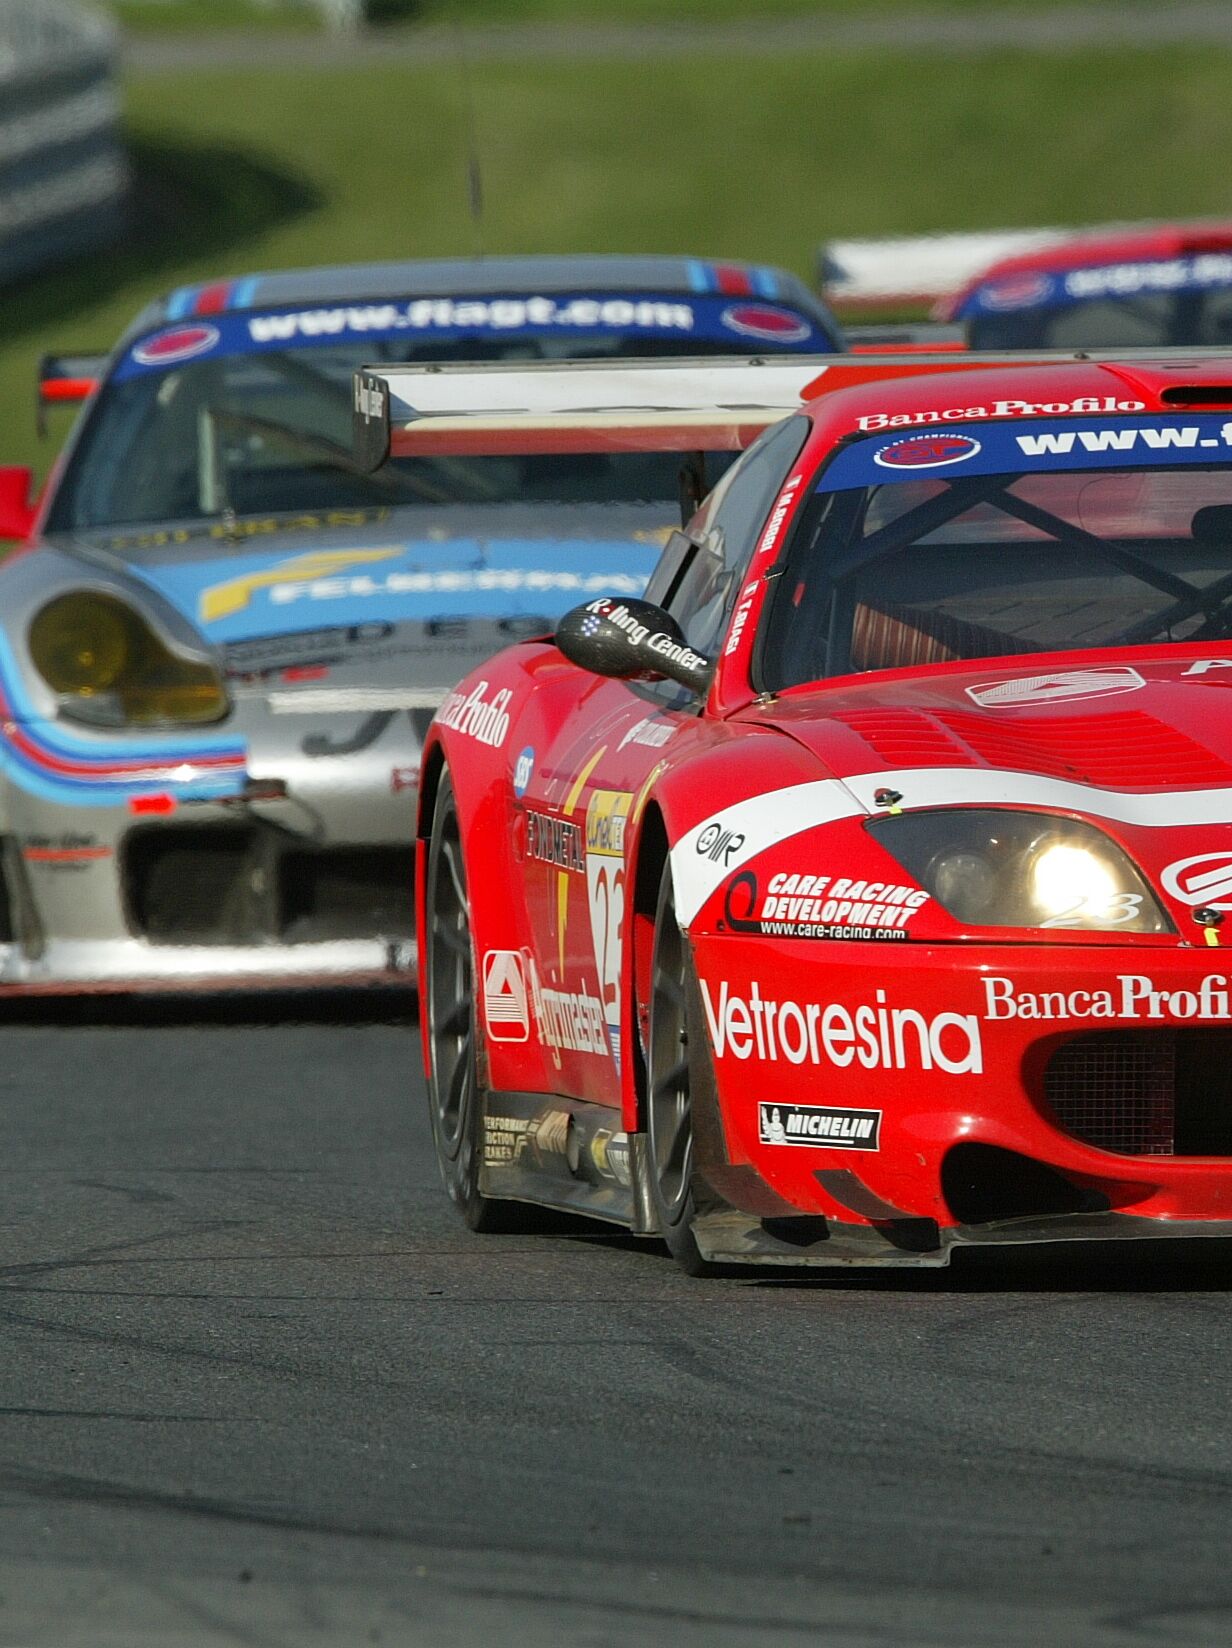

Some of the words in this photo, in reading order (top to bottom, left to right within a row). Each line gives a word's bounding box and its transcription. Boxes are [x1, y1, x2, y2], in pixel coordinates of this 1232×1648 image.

[250, 298, 694, 341] www.fiagt.com
[647, 632, 708, 671] Center
[767, 872, 832, 897] CARE
[828, 878, 931, 908] RACING
[761, 896, 919, 928] DEVELOPMENT
[760, 921, 906, 940] www.care-racing.com
[699, 978, 984, 1075] Vetroresina
[786, 1113, 875, 1139] MICHELIN
